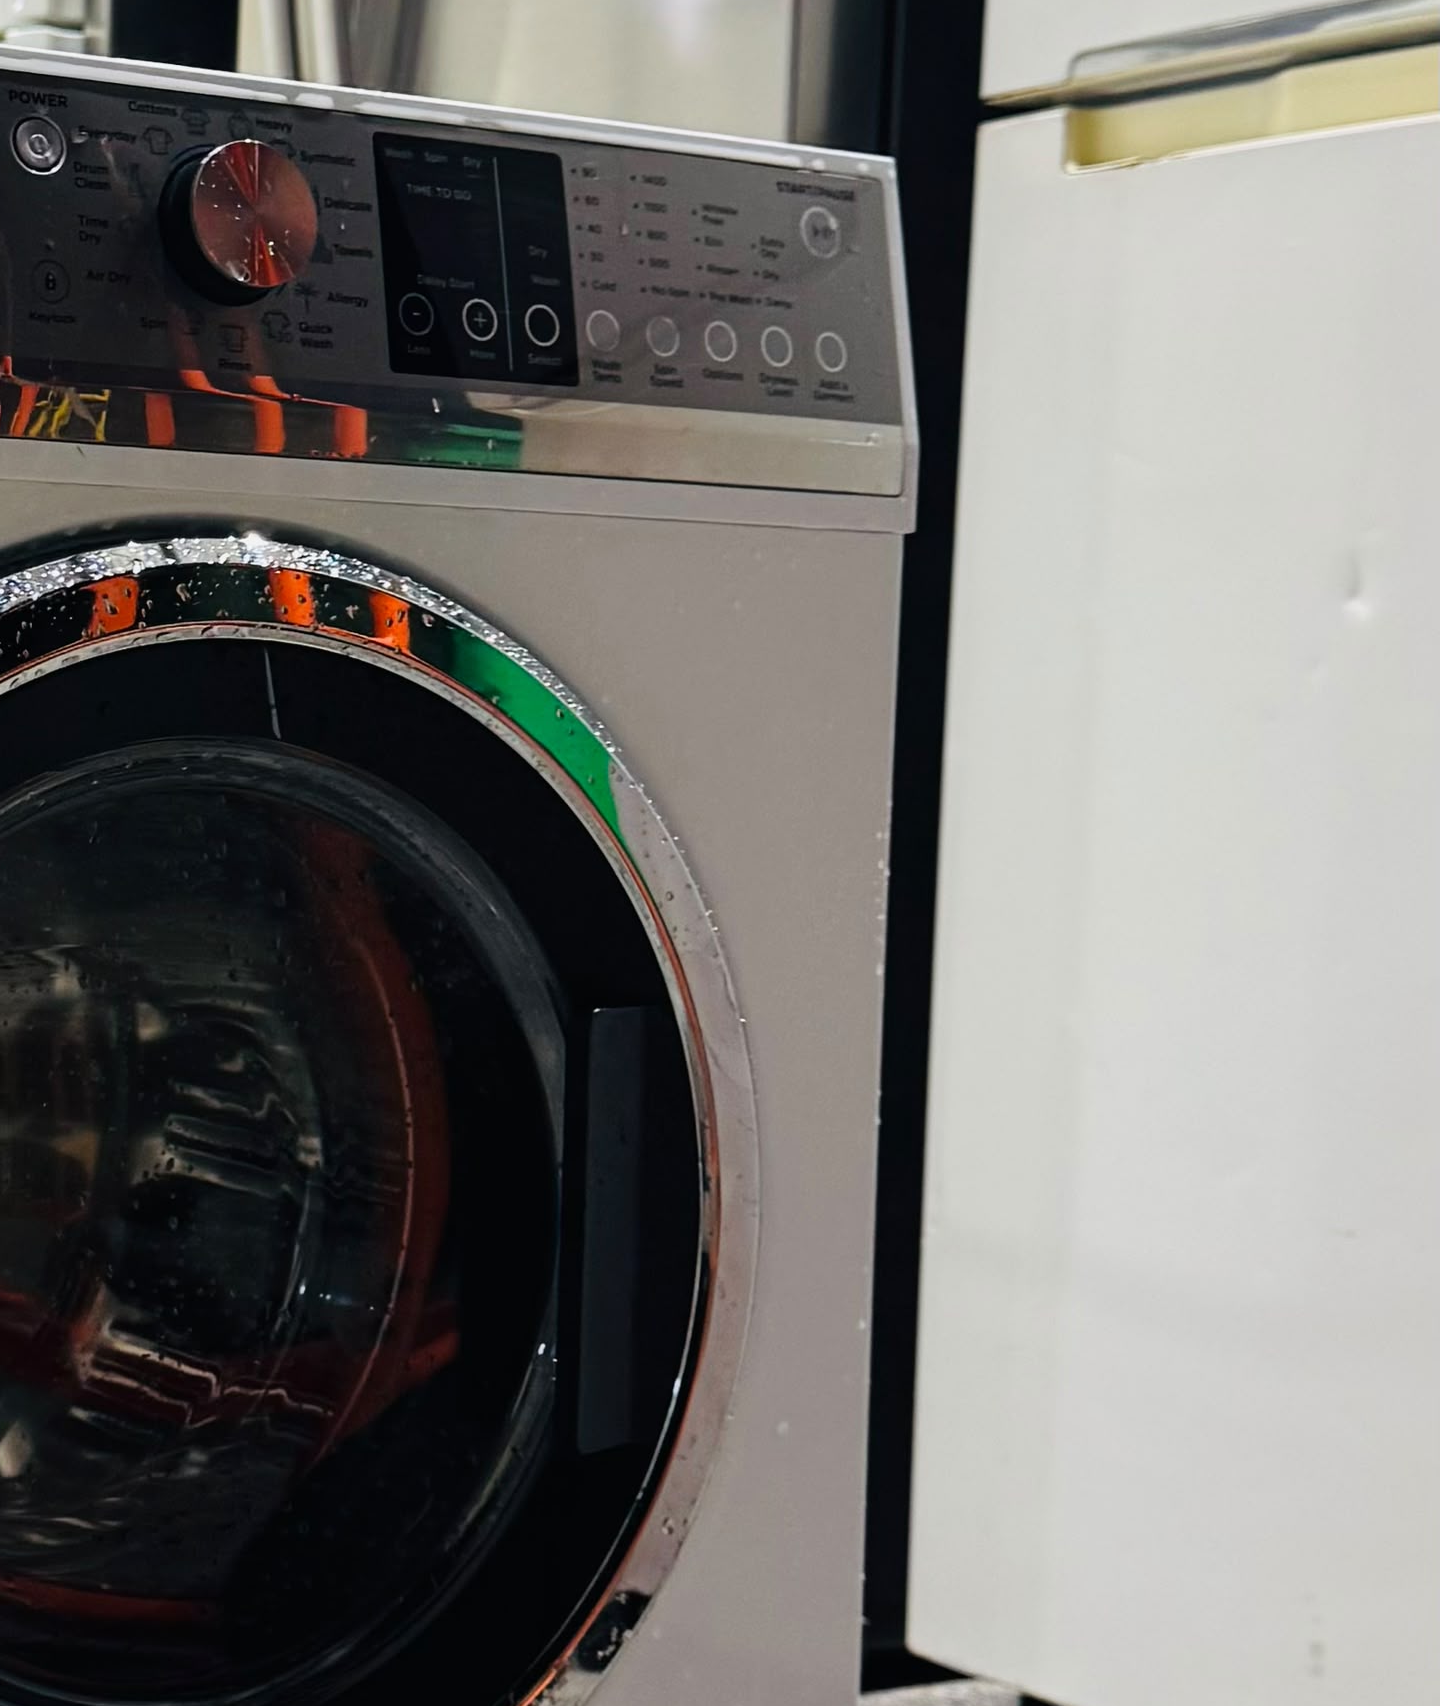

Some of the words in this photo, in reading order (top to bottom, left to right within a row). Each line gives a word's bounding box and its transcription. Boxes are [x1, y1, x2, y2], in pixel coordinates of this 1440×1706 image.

[9, 90, 68, 107] POWER
[128, 101, 177, 117] Cottons
[78, 125, 137, 144] Everyday
[74, 161, 109, 175] Drum
[78, 215, 109, 228] Time
[79, 230, 101, 244] Dry
[86, 269, 105, 282] Air
[107, 270, 132, 285] Dry
[327, 292, 368, 308] Allergy
[299, 321, 333, 333] Quick
